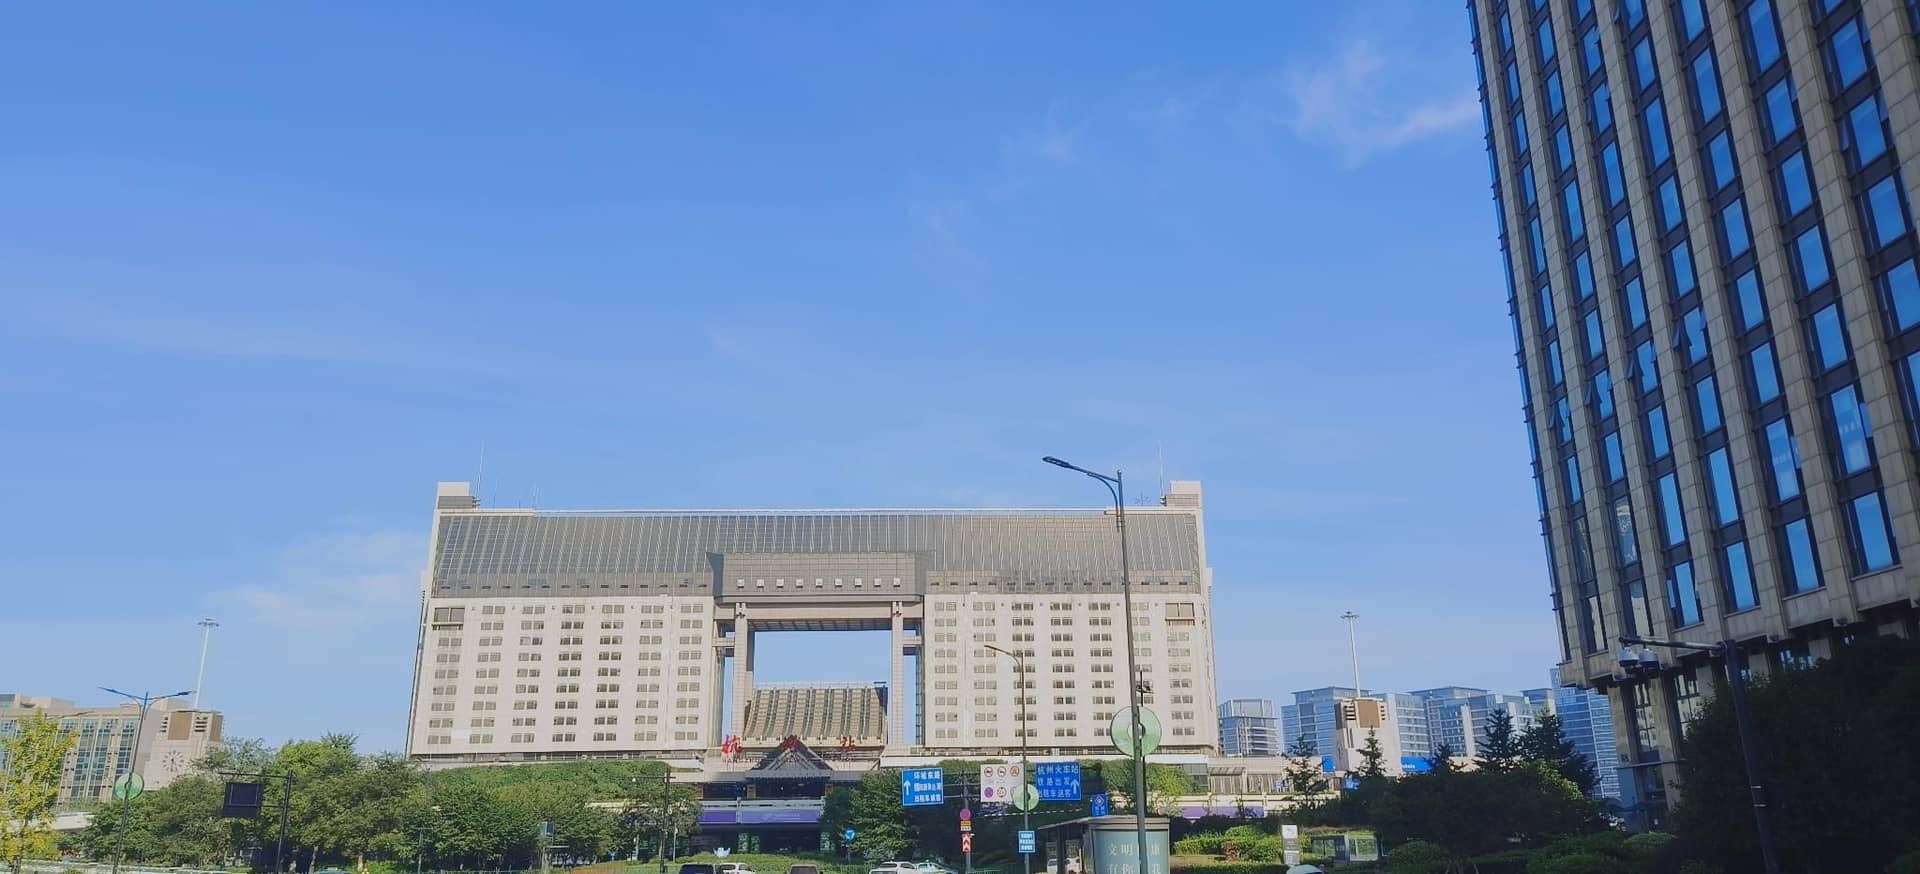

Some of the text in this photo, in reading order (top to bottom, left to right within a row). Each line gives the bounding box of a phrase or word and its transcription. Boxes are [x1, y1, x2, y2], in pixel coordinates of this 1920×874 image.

[1037, 764, 1079, 775] 杭州火车站
[1037, 777, 1070, 786] 铁路出发
